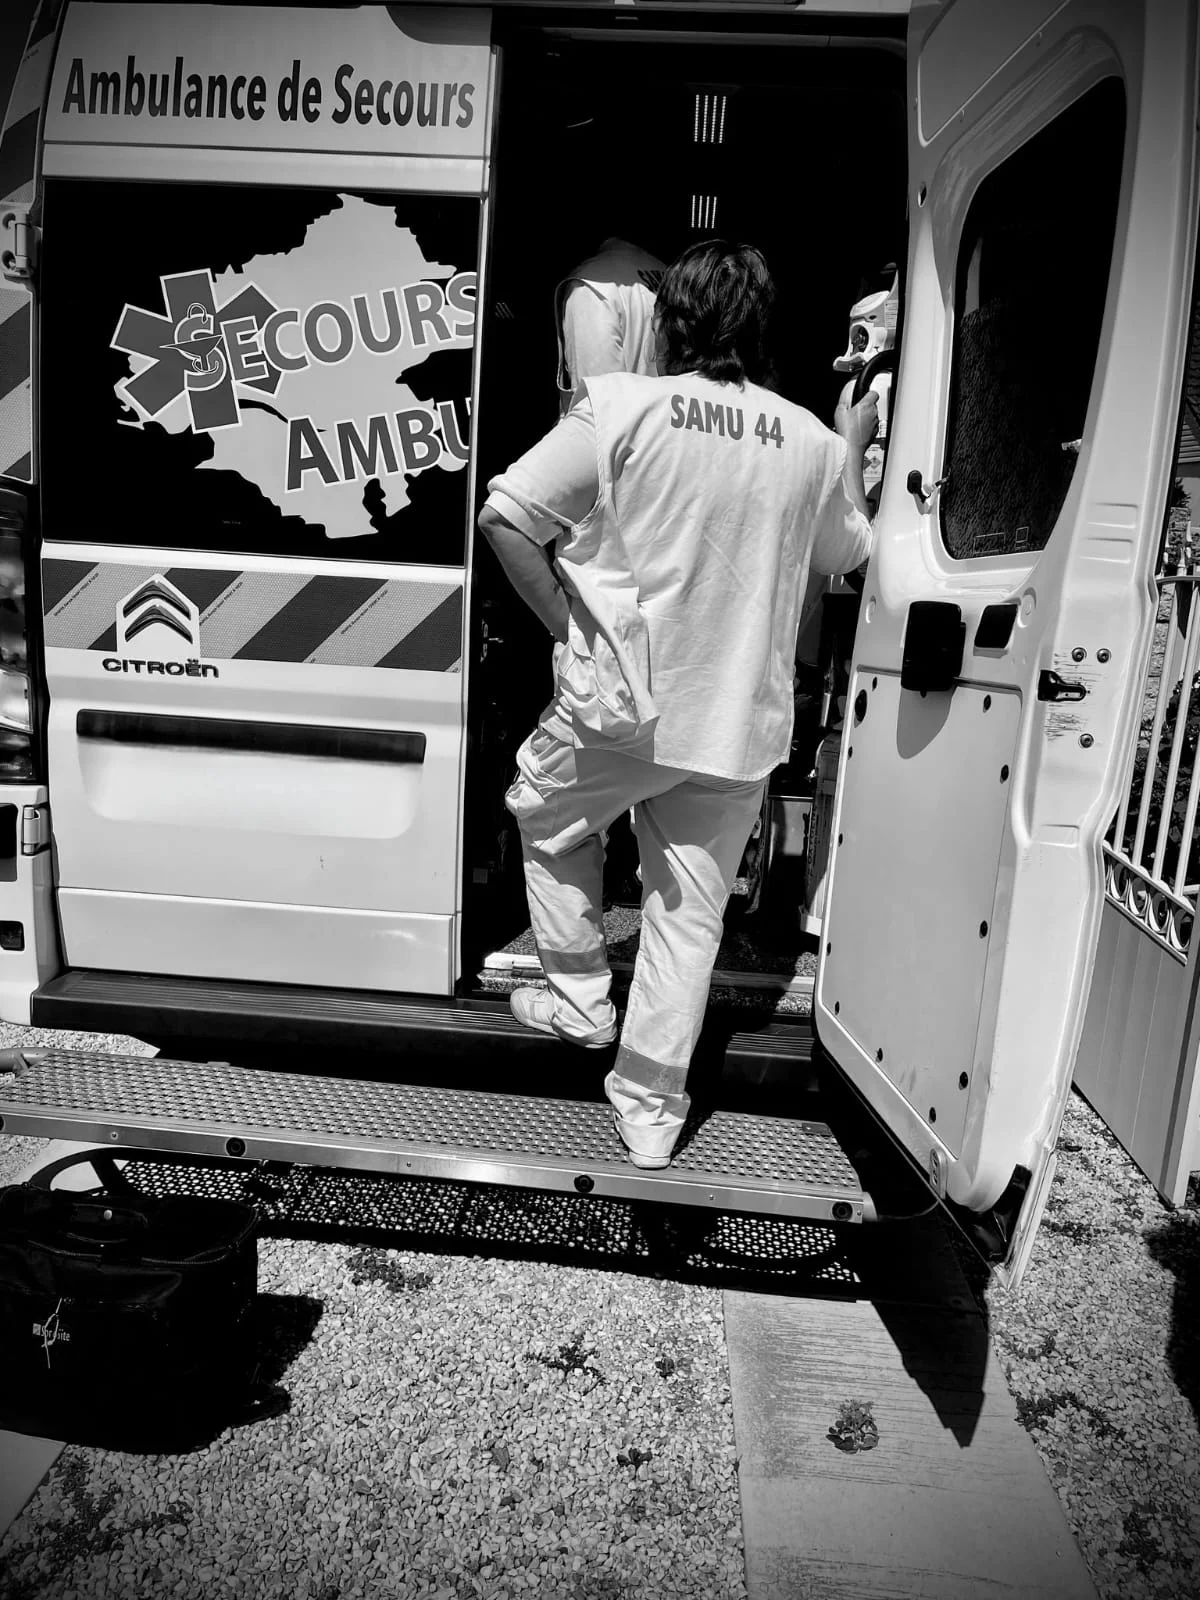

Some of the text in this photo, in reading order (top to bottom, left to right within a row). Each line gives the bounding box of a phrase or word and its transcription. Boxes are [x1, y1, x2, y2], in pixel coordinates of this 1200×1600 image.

[62, 55, 476, 129] Ambulance de Secours
[173, 271, 477, 391] SECOURS
[670, 394, 785, 449] SAMU 44
